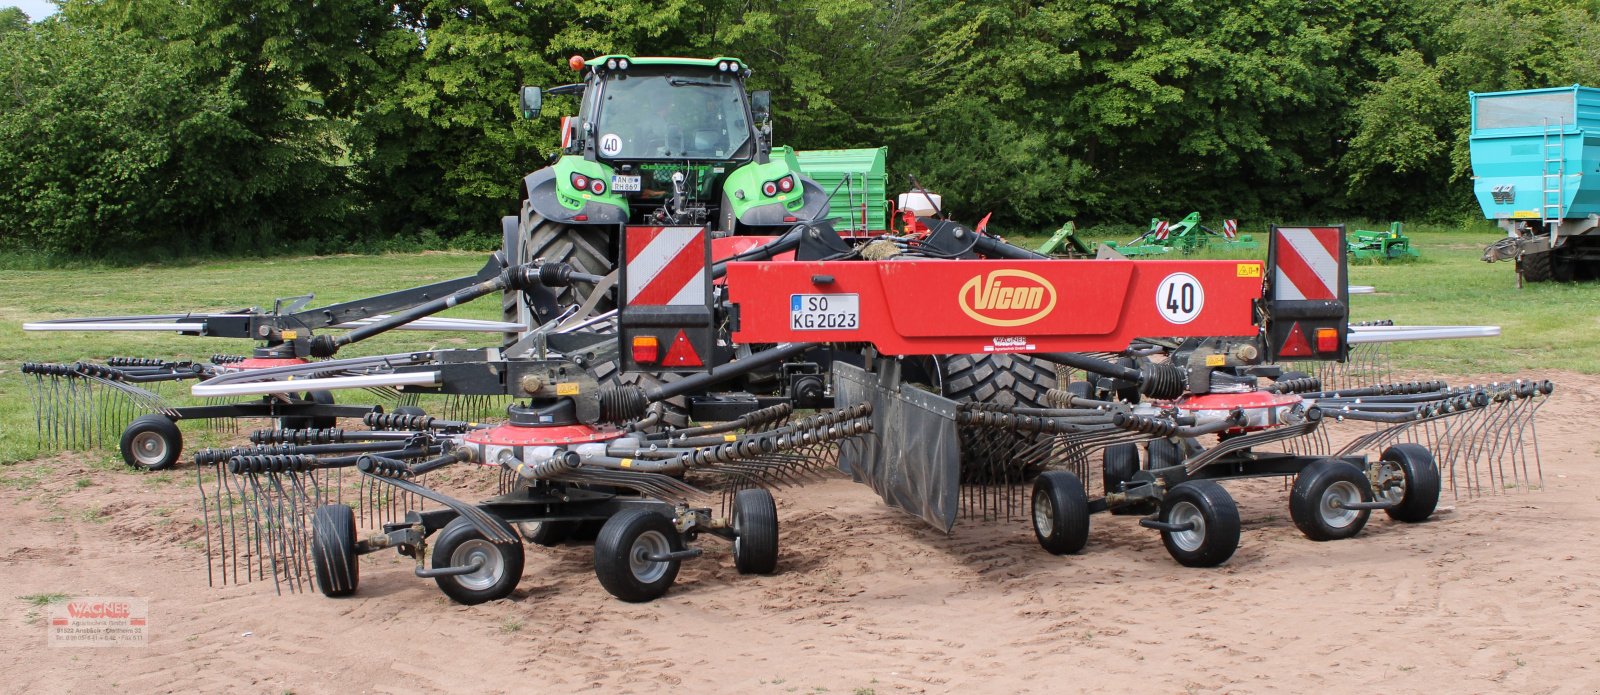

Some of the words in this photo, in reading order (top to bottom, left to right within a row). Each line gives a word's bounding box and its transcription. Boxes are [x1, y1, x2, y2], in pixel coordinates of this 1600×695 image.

[604, 138, 618, 152] 40
[974, 275, 1044, 310] Vicon
[1166, 282, 1194, 314] 40
[808, 297, 828, 311] SO
[794, 313, 814, 328] KG
[817, 313, 856, 328] 2023
[993, 336, 1027, 346] WAGNER
